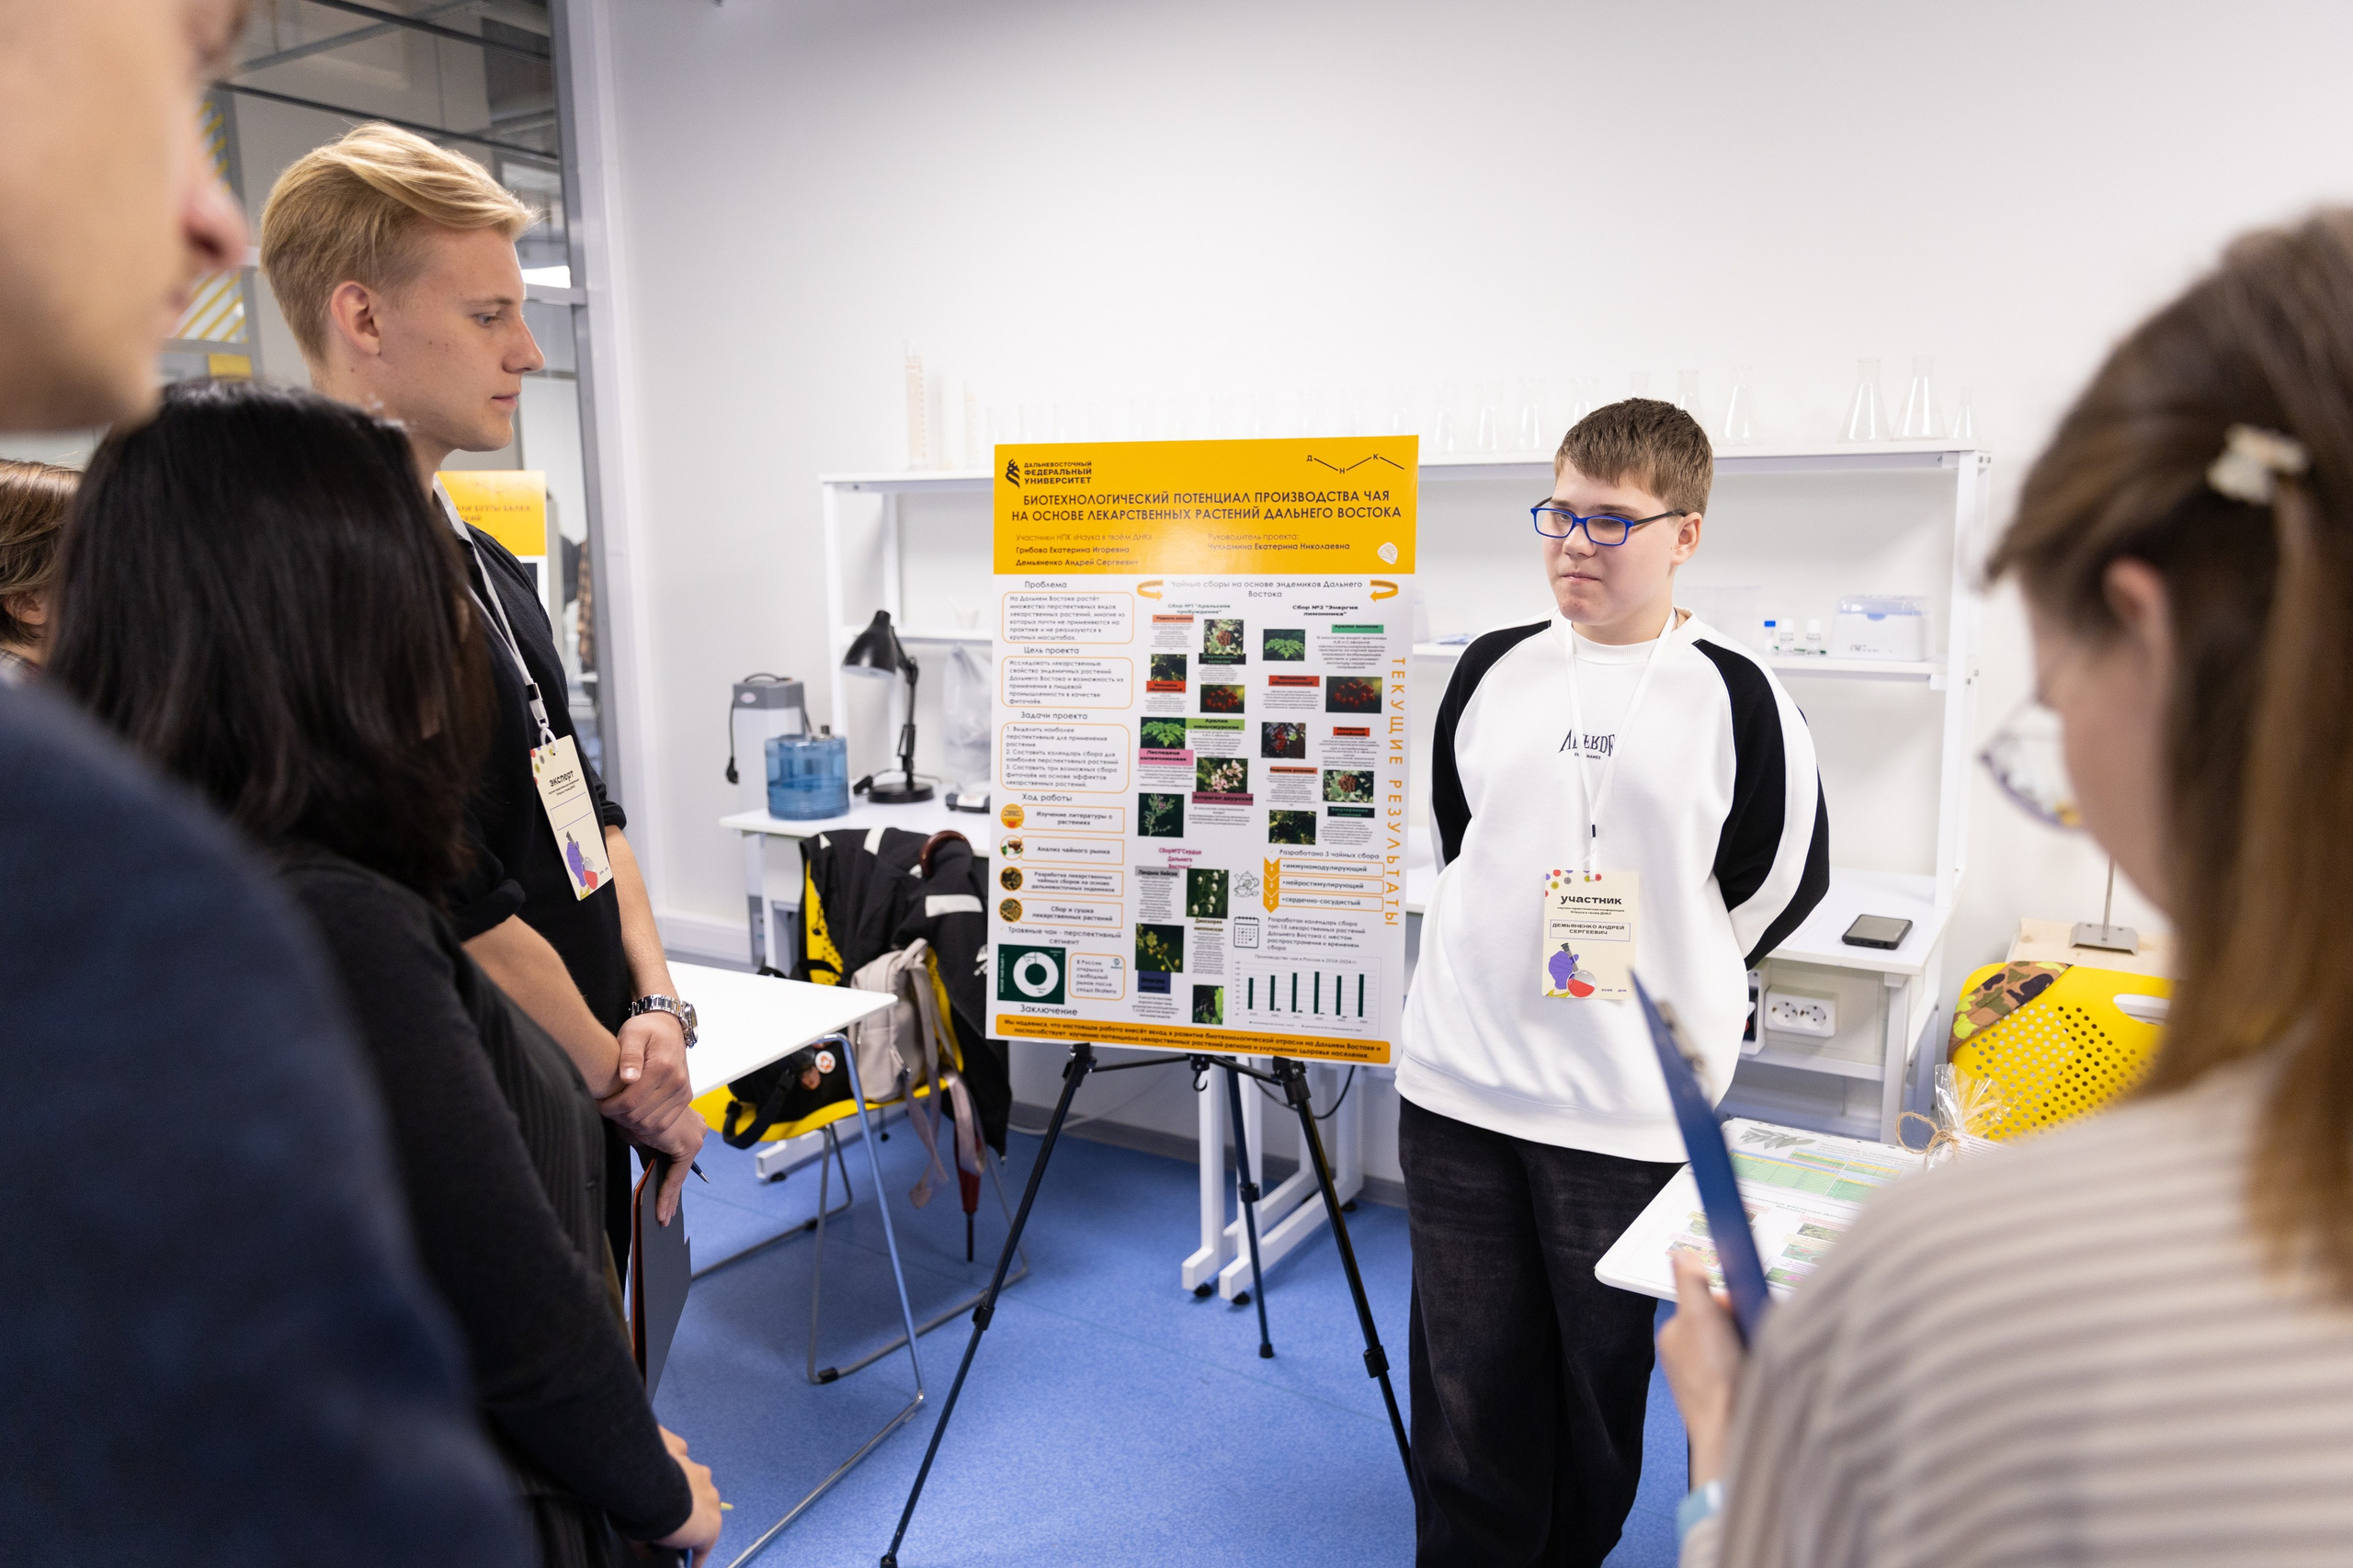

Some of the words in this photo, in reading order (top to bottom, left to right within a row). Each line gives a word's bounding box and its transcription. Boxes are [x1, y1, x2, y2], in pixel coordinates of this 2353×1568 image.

[1024, 491, 1169, 506] БИОТЕХНОЛОГИЧЕСКИЙ
[1174, 492, 1250, 505] ПОТЕНЦИАЛ
[1255, 491, 1359, 503] ПРОИЗВОДСТВА
[1364, 491, 1390, 502] ЧАЯ
[1012, 512, 1029, 521] НА
[1032, 510, 1084, 521] ОСНОВЕ
[1088, 509, 1191, 520] ЛЕКАРСТВЕННЫХ
[1195, 506, 1260, 519] РАСТЕНИЙ
[1264, 507, 1333, 519] ДАЛЬНЕГО
[1338, 507, 1401, 517] ВОСТОКА
[1016, 547, 1048, 555] Грибова
[1064, 559, 1094, 567] Андрей
[1388, 657, 1405, 765] ТЕКУЩИЕ
[550, 770, 574, 787] эксперт
[1040, 794, 1072, 802] работы
[1385, 779, 1403, 926] РЕЗУЛЬТАТЫ
[1286, 864, 1367, 872] иммуномодулирующий
[1286, 881, 1364, 889] нейростимулирующий
[1285, 897, 1360, 905] сердечно-сосудистый
[1561, 896, 1621, 904] участник
[1064, 930, 1121, 938] перспективный
[1020, 1004, 1078, 1016] Заключение
